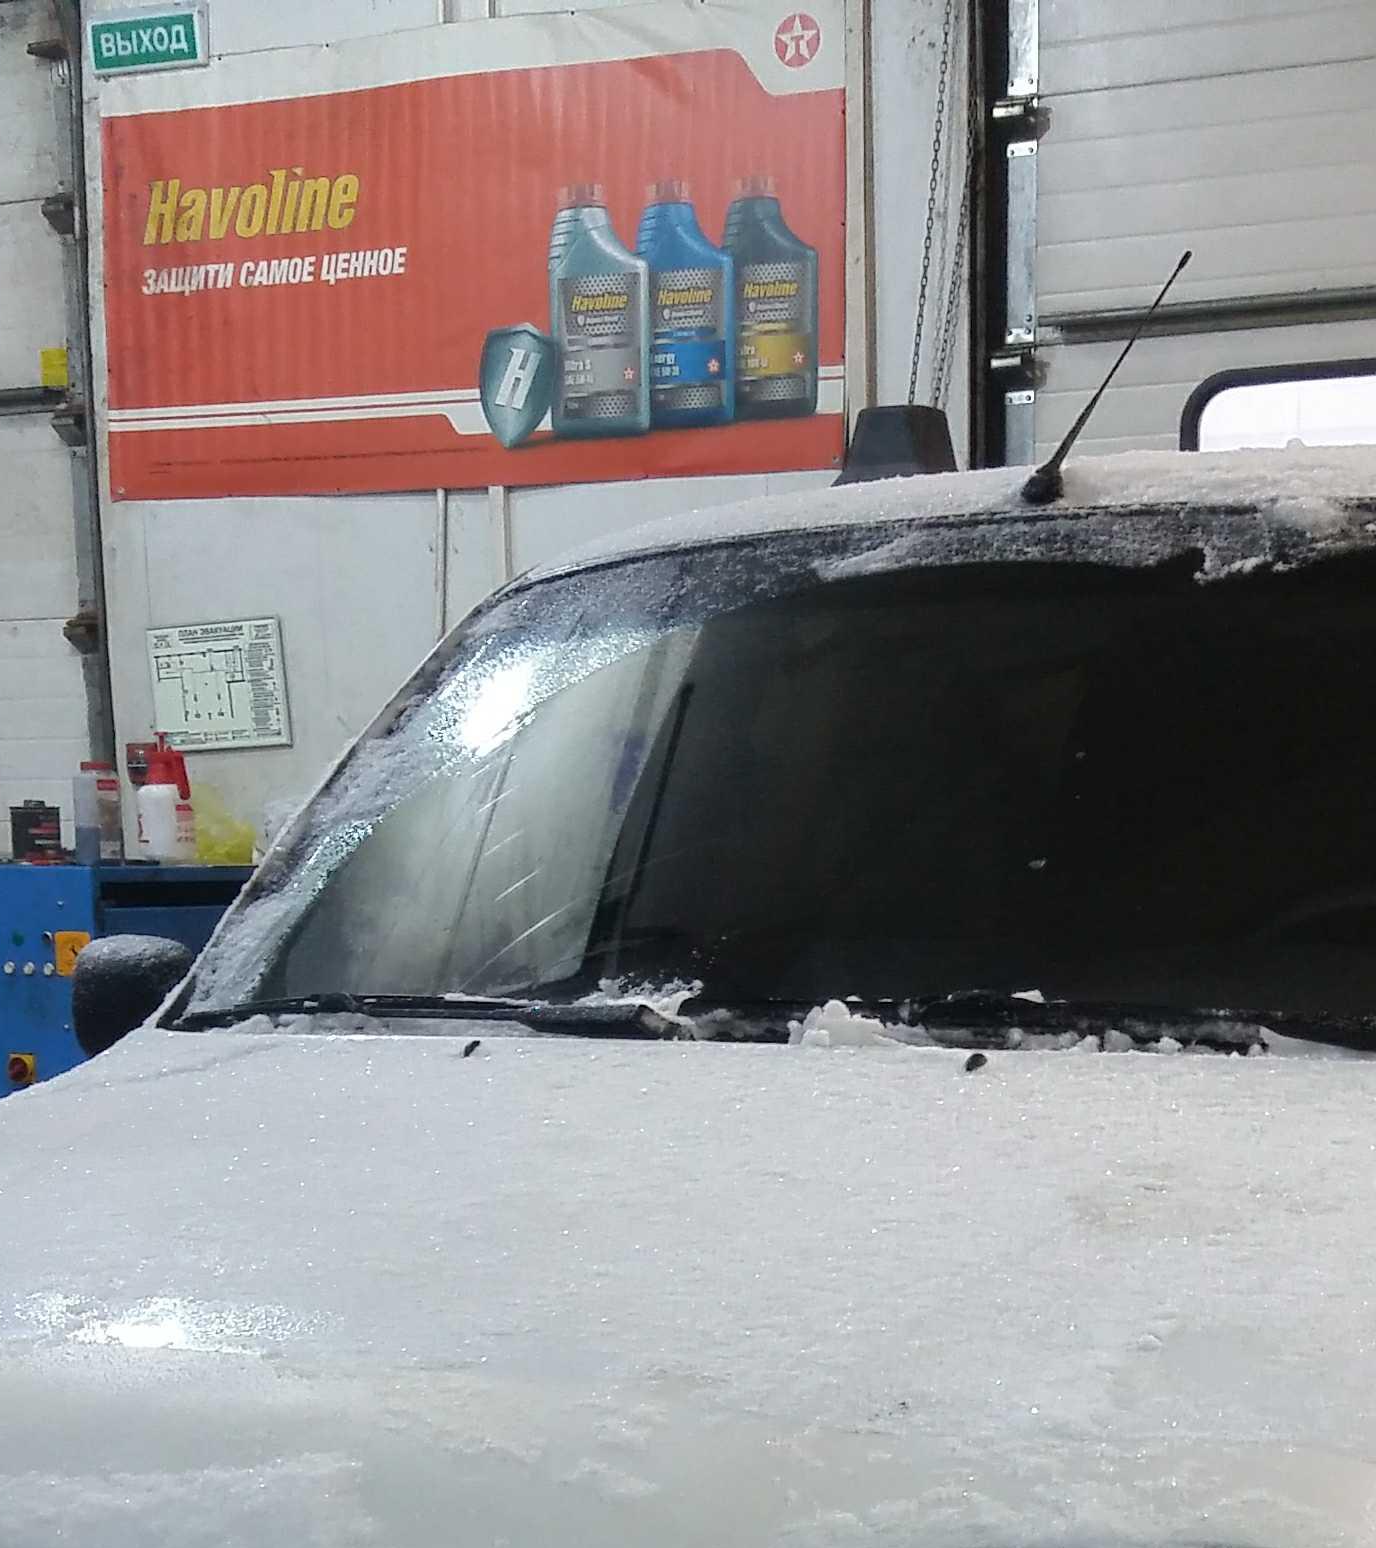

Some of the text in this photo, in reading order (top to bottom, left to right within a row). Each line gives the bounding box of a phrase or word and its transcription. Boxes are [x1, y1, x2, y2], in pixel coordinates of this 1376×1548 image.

[100, 24, 188, 58] ВЫХОД
[143, 166, 360, 246] Havoline
[142, 247, 407, 296] ЗАЩИТИ САМОЕ ЦЕННОЕ
